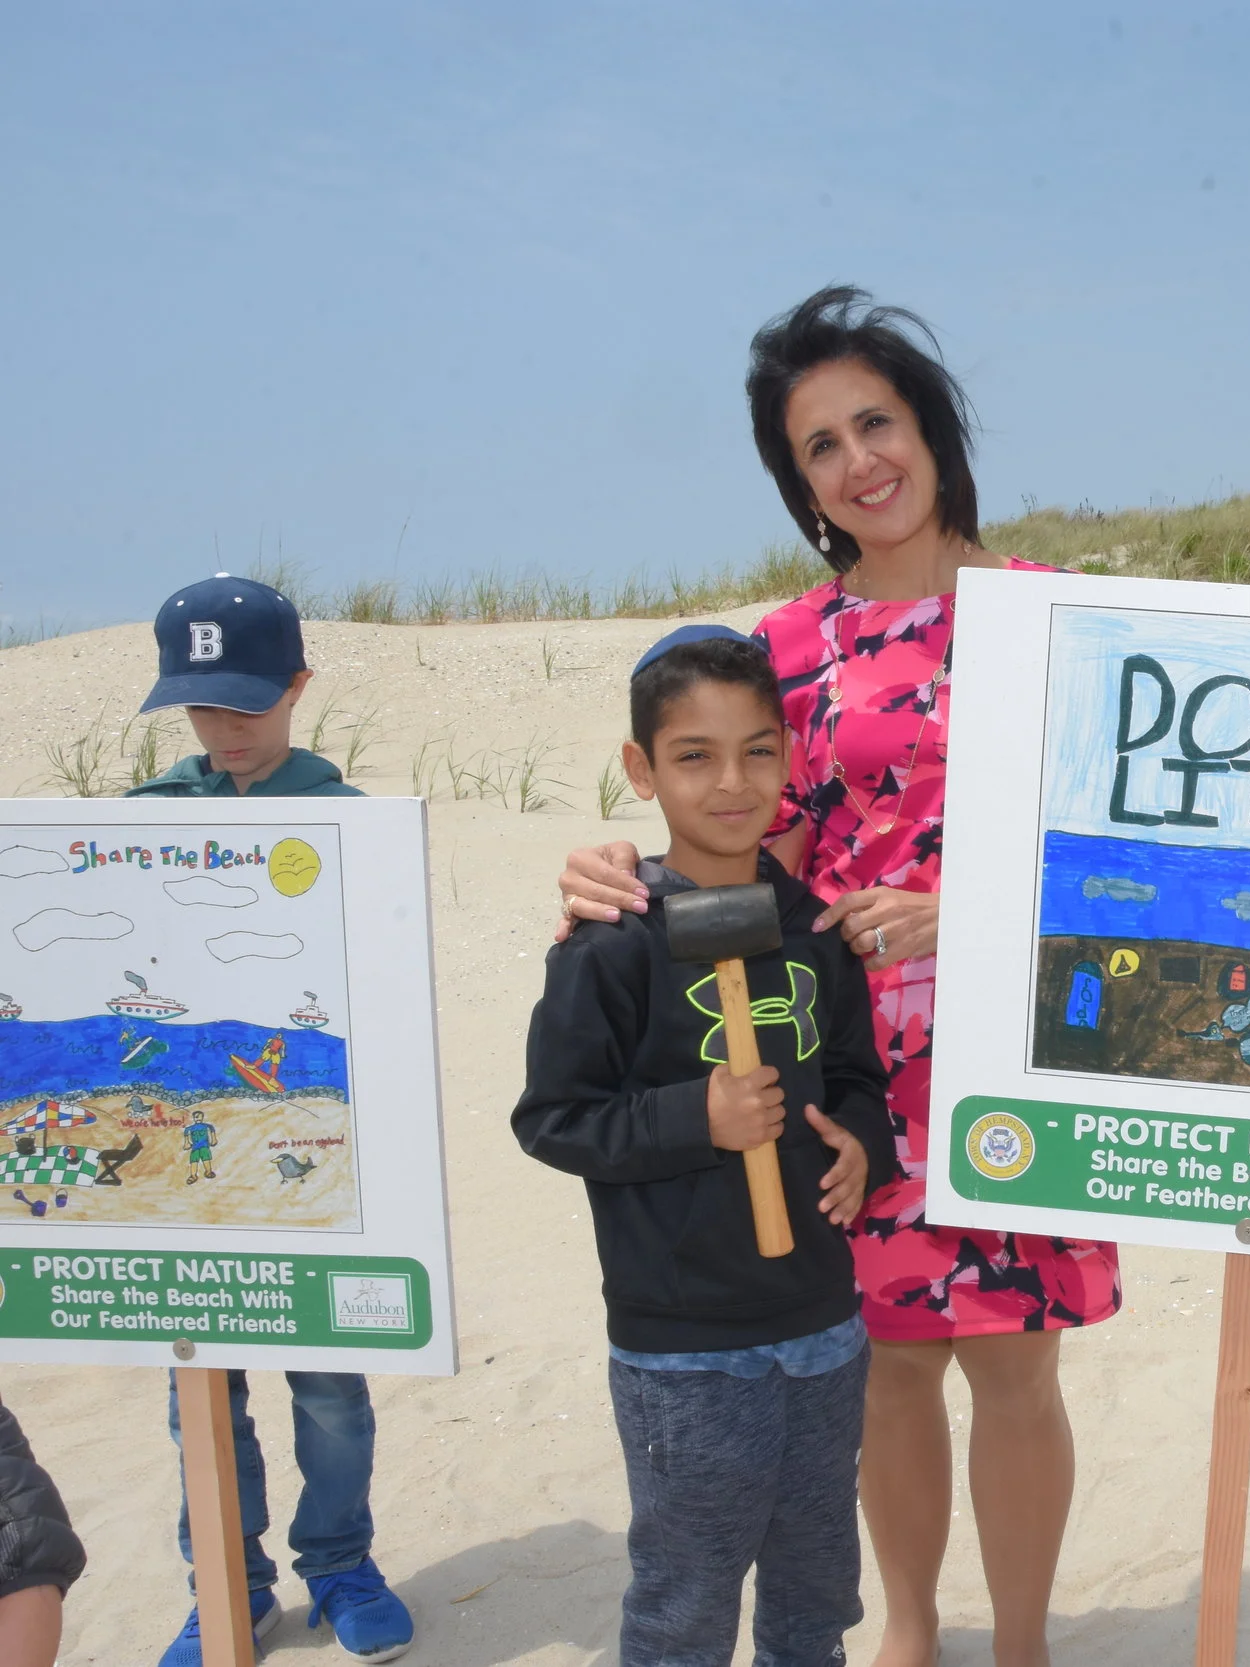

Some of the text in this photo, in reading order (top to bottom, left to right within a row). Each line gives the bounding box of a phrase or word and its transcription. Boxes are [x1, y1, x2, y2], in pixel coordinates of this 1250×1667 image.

[189, 622, 223, 662] B
[69, 840, 266, 874] Share The Beach
[1074, 1113, 1235, 1154] PROTECT
[1090, 1150, 1169, 1177] Share
[1178, 1157, 1222, 1182] the
[1087, 1178, 1137, 1202] Our
[34, 1256, 163, 1282] PROTECT
[176, 1259, 294, 1285] NATURE
[51, 1285, 293, 1310] Share the Beach With
[340, 1300, 404, 1315] Audubon
[50, 1310, 297, 1334] Our Feathered Friends
